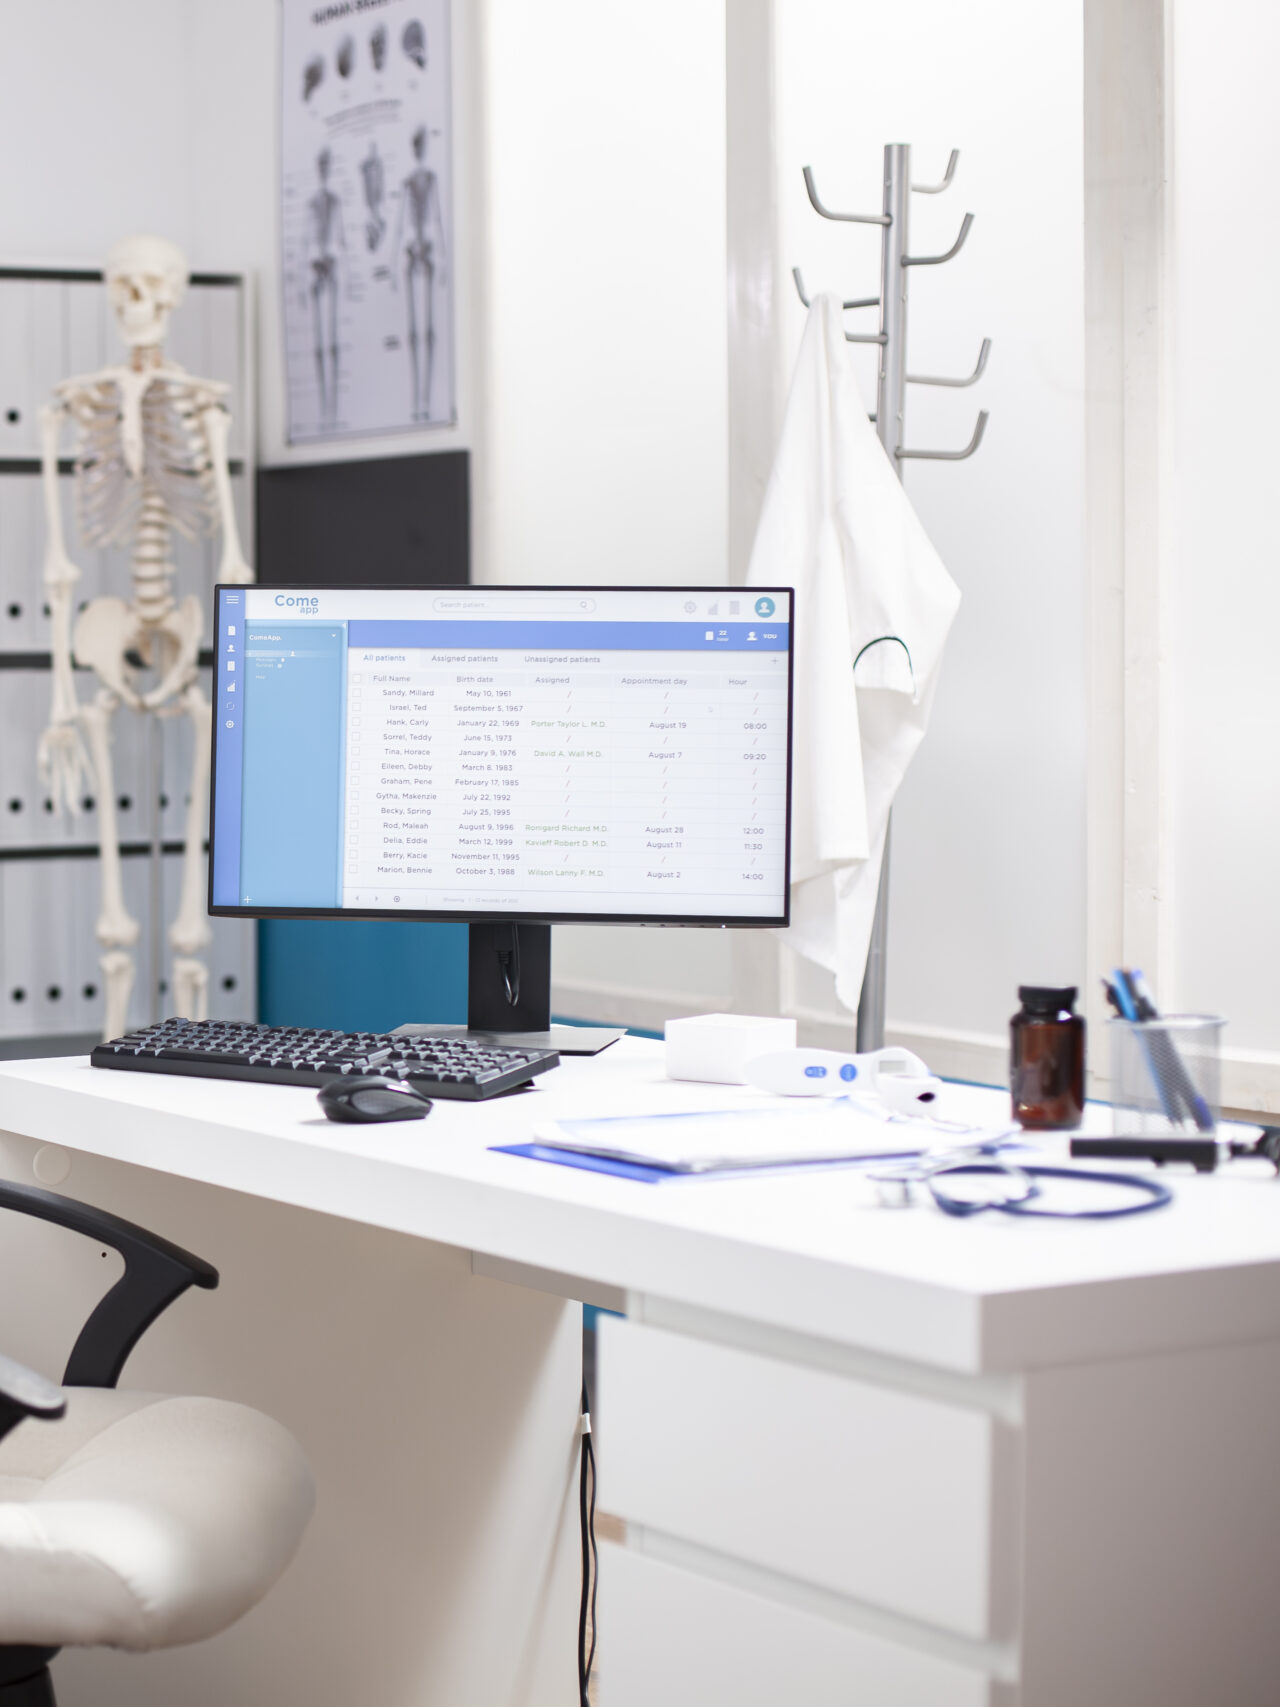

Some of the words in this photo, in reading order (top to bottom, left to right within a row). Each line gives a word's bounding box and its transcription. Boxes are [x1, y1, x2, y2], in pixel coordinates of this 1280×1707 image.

[275, 594, 319, 606] Come
[300, 606, 319, 615] app
[431, 655, 466, 663] Assigned
[525, 656, 568, 664] Unassigned
[570, 656, 600, 664] patients
[535, 677, 570, 685] Assigned
[673, 678, 687, 686] day
[466, 690, 481, 698] May
[409, 719, 429, 727] Carly
[649, 722, 676, 730] August
[410, 734, 432, 742] Teddy
[408, 763, 432, 772] Debby
[455, 779, 489, 787] February
[407, 808, 431, 816] Spring
[645, 826, 672, 834] August
[646, 841, 674, 849] August
[407, 851, 427, 859] Kacie
[456, 867, 487, 875] October
[647, 871, 674, 879] August
